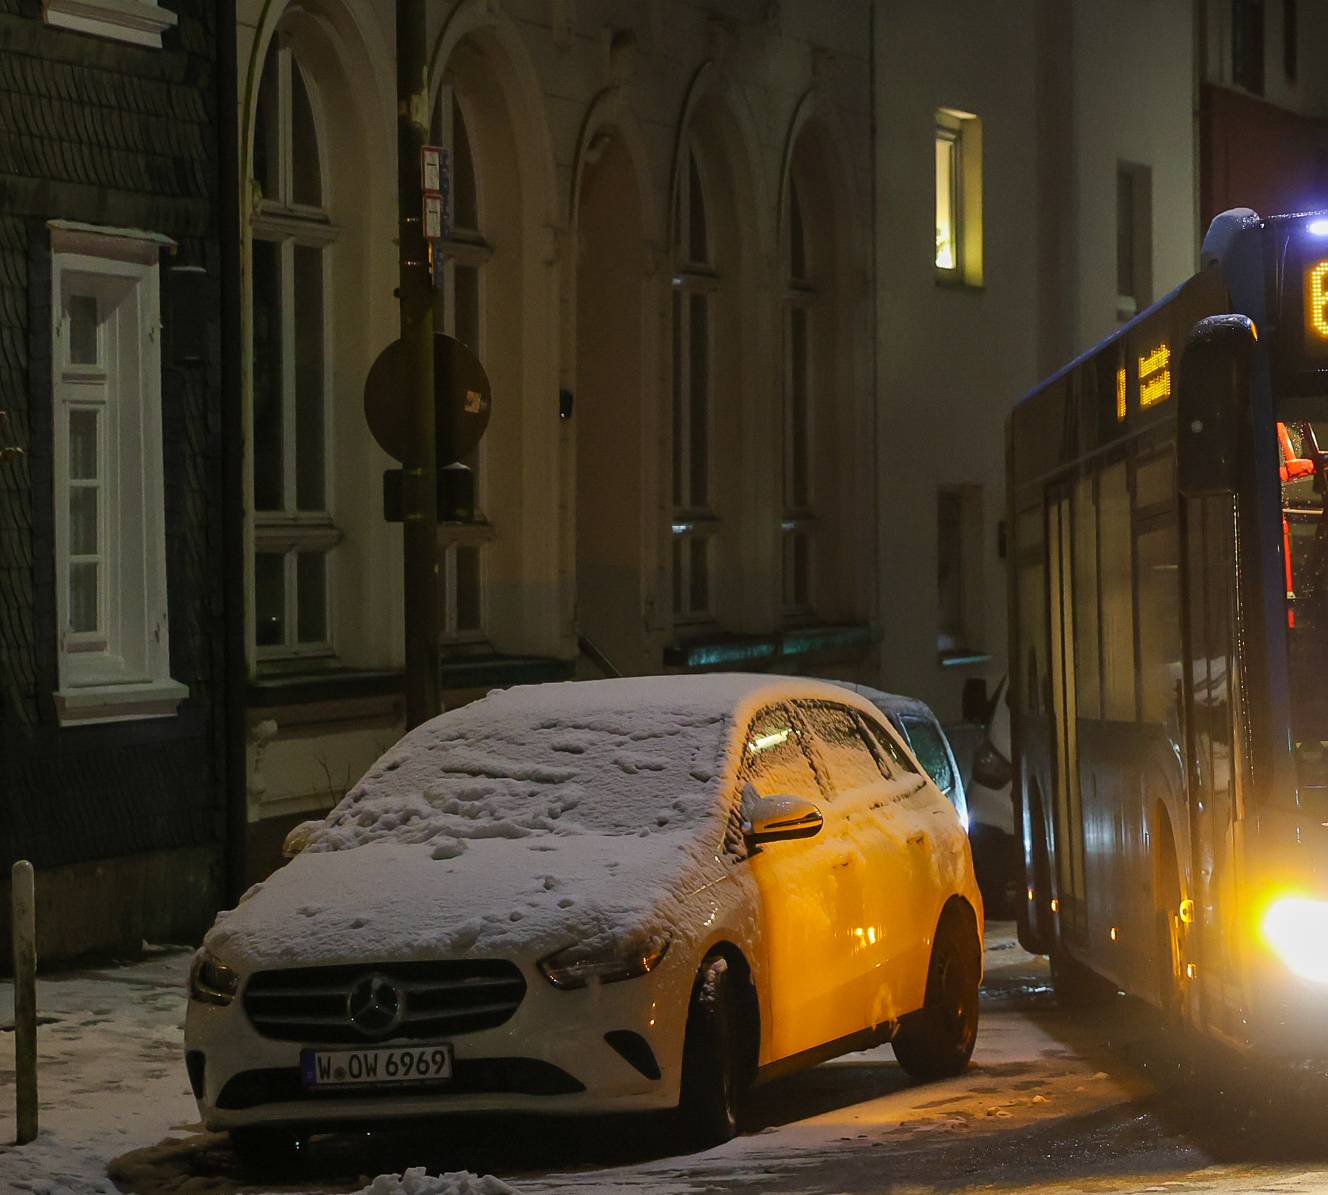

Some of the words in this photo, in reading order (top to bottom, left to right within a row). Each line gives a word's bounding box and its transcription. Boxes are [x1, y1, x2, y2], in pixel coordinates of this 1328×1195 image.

[317, 1055, 332, 1081] W
[348, 1053, 378, 1079] OW
[385, 1050, 446, 1077] 6969
